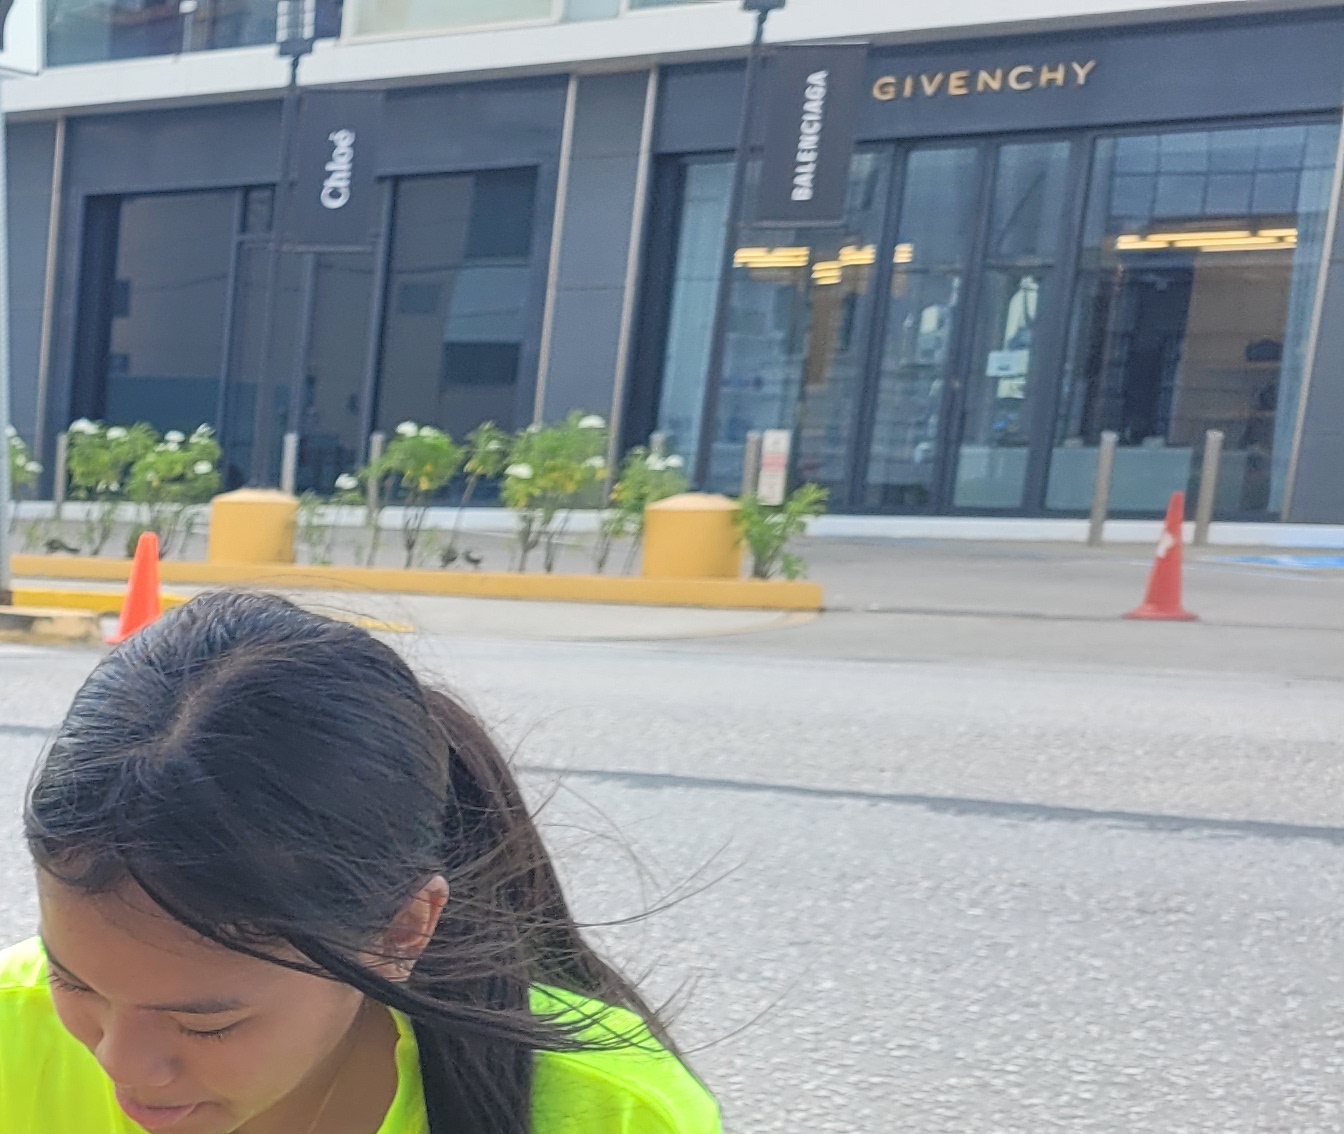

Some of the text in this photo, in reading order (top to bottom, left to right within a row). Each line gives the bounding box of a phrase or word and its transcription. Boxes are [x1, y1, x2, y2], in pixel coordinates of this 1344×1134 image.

[872, 59, 1097, 101] GIVENCHY
[320, 128, 356, 209] Chloé
[791, 69, 829, 201] BALENCIAGA
